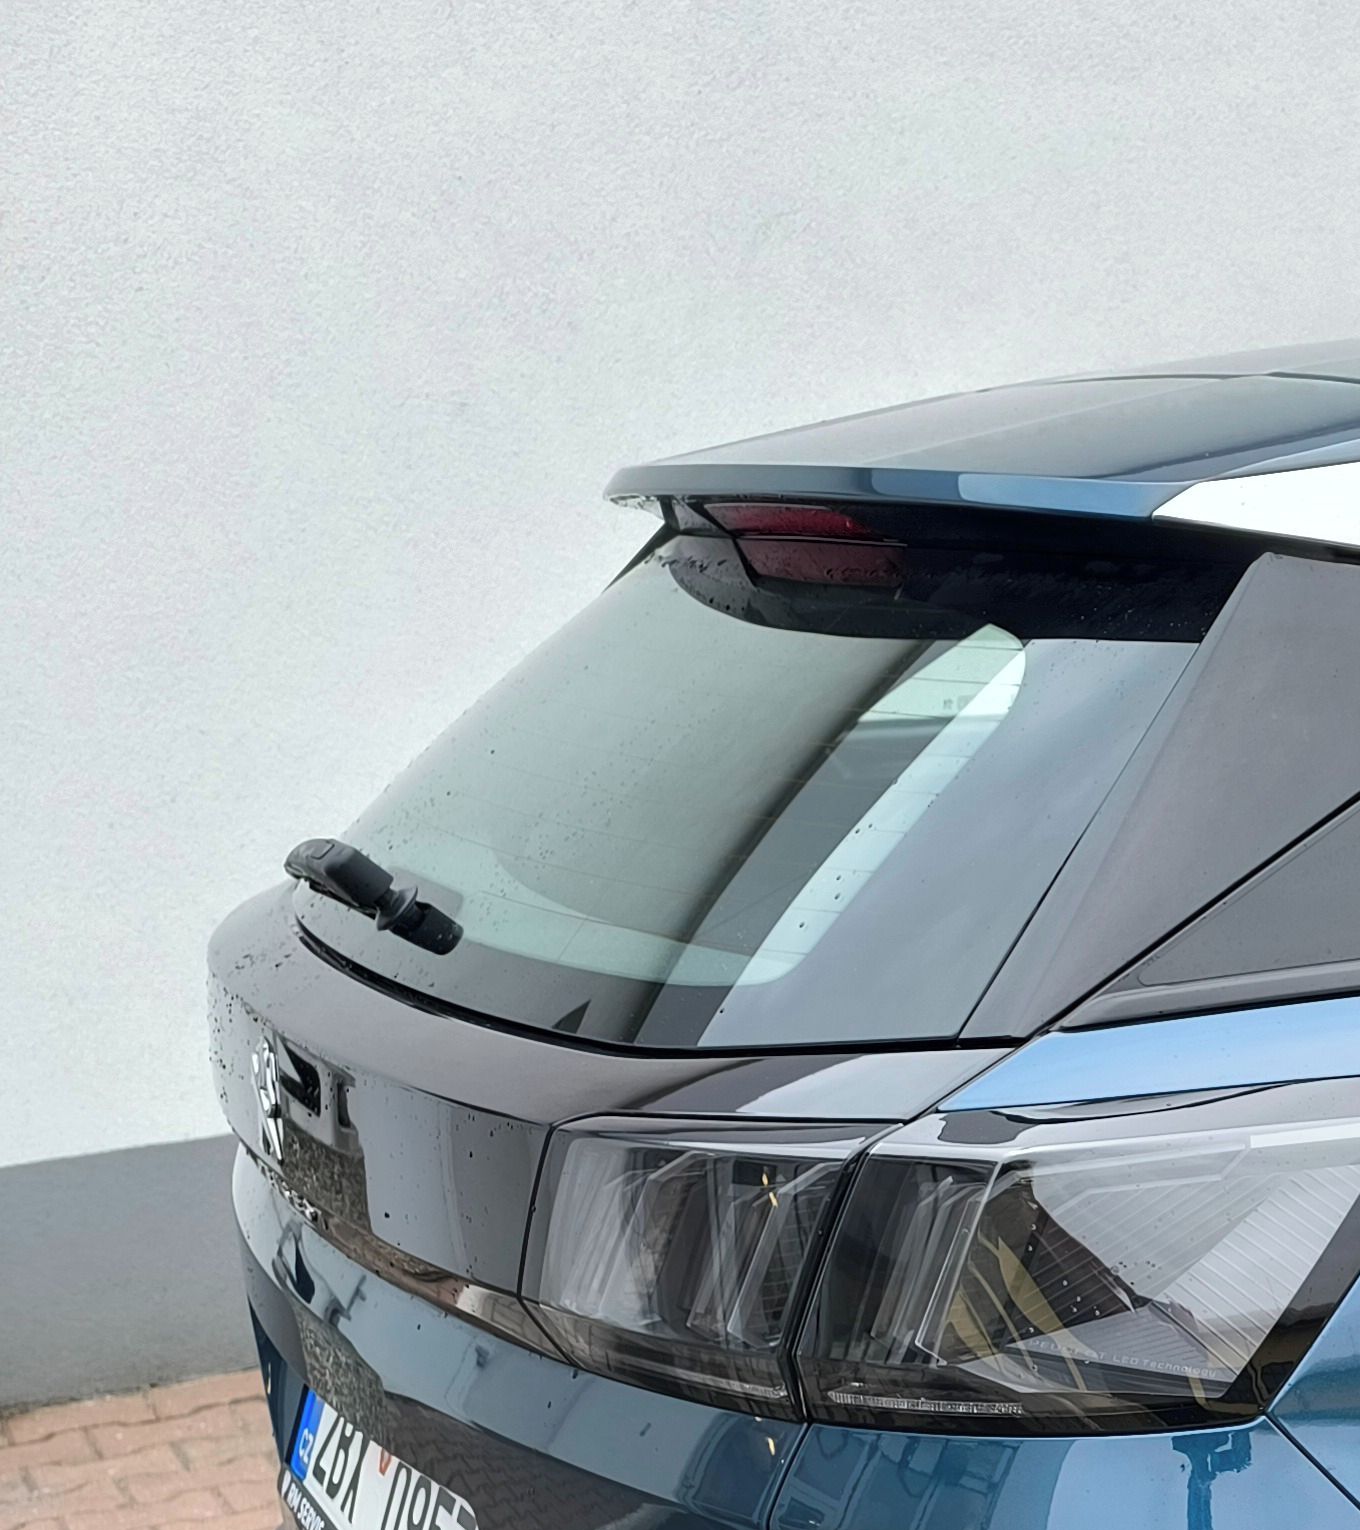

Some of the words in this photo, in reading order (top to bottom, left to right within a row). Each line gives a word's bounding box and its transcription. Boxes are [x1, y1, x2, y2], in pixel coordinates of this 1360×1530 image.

[1113, 1354, 1138, 1366] LED
[1142, 1358, 1216, 1379] Technology
[299, 1428, 313, 1465] CZ
